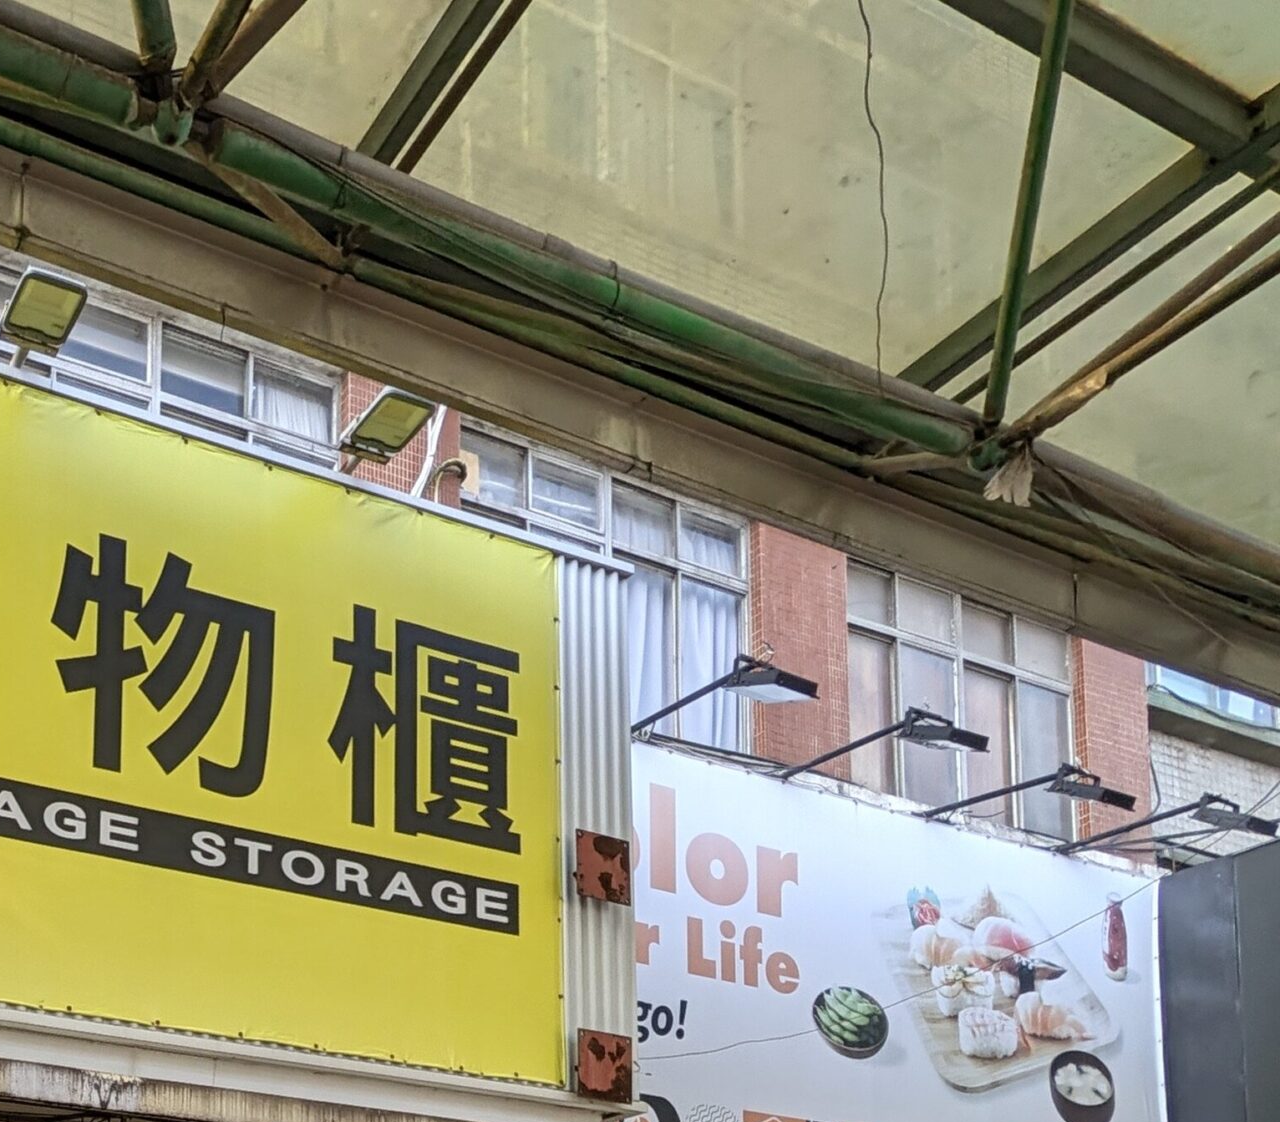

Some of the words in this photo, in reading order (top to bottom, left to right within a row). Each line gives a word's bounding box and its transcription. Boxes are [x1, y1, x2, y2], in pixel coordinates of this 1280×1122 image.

[190, 829, 510, 927] STORAGE
[632, 783, 799, 918] lor
[687, 916, 801, 994] Life
